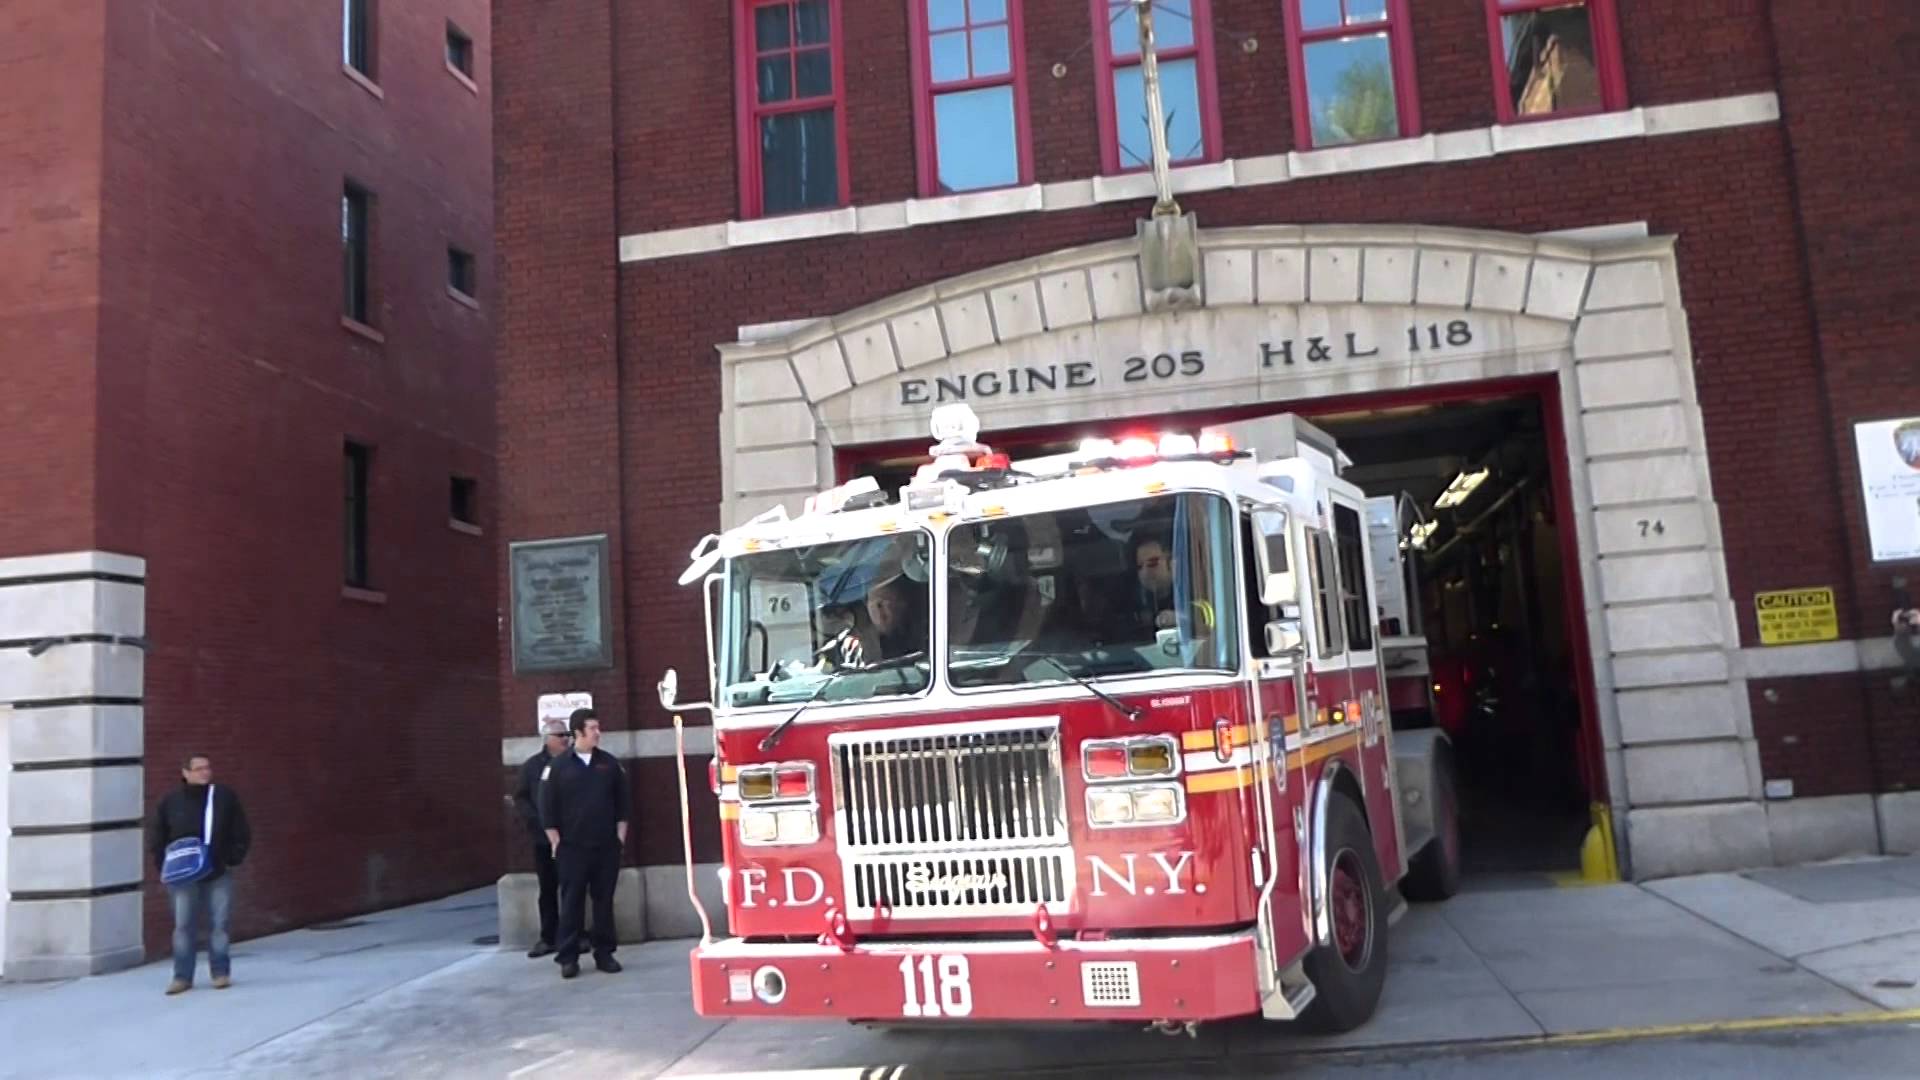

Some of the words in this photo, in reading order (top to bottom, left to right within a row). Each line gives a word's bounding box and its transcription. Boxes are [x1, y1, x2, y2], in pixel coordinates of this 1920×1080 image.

[900, 362, 1096, 405] ENGINE
[1123, 351, 1205, 382] 205
[1408, 320, 1472, 351] 118
[1637, 519, 1665, 538] 74
[769, 597, 791, 613] 76
[1760, 592, 1829, 609] CAUTION
[739, 867, 835, 908] F.D.
[1086, 850, 1207, 897] N.Y.
[899, 954, 973, 1017] 118
